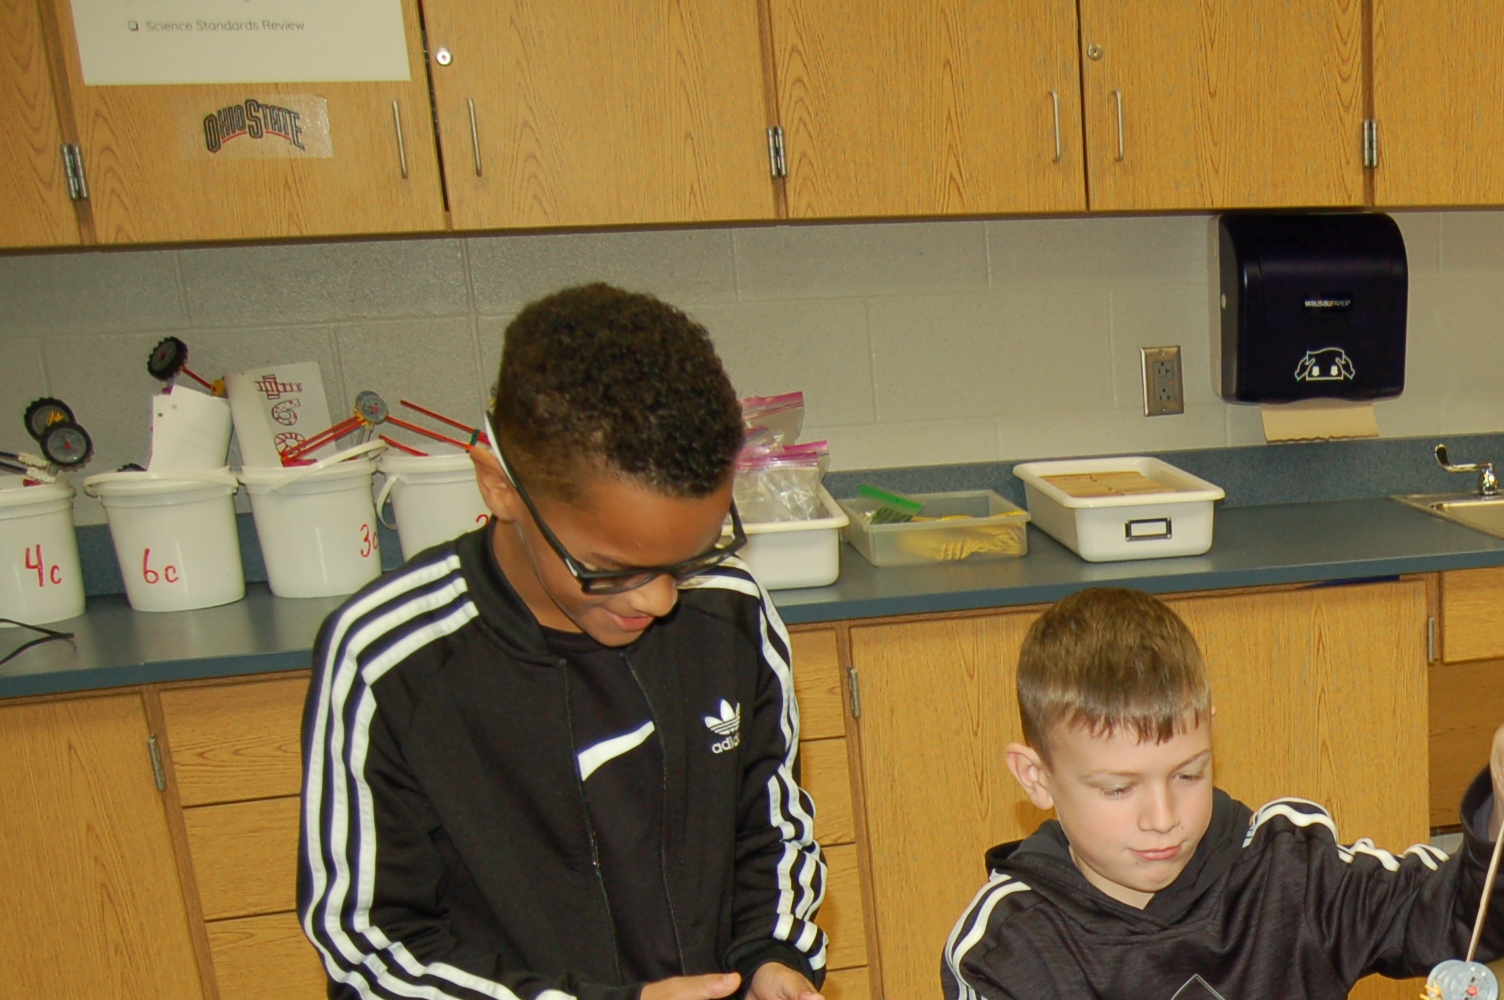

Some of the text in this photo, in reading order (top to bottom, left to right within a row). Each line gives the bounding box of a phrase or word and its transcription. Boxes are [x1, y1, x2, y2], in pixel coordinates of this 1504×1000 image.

[145, 20, 305, 31] Science Standards Review
[24, 543, 63, 588] 4c
[142, 548, 180, 585] 6c
